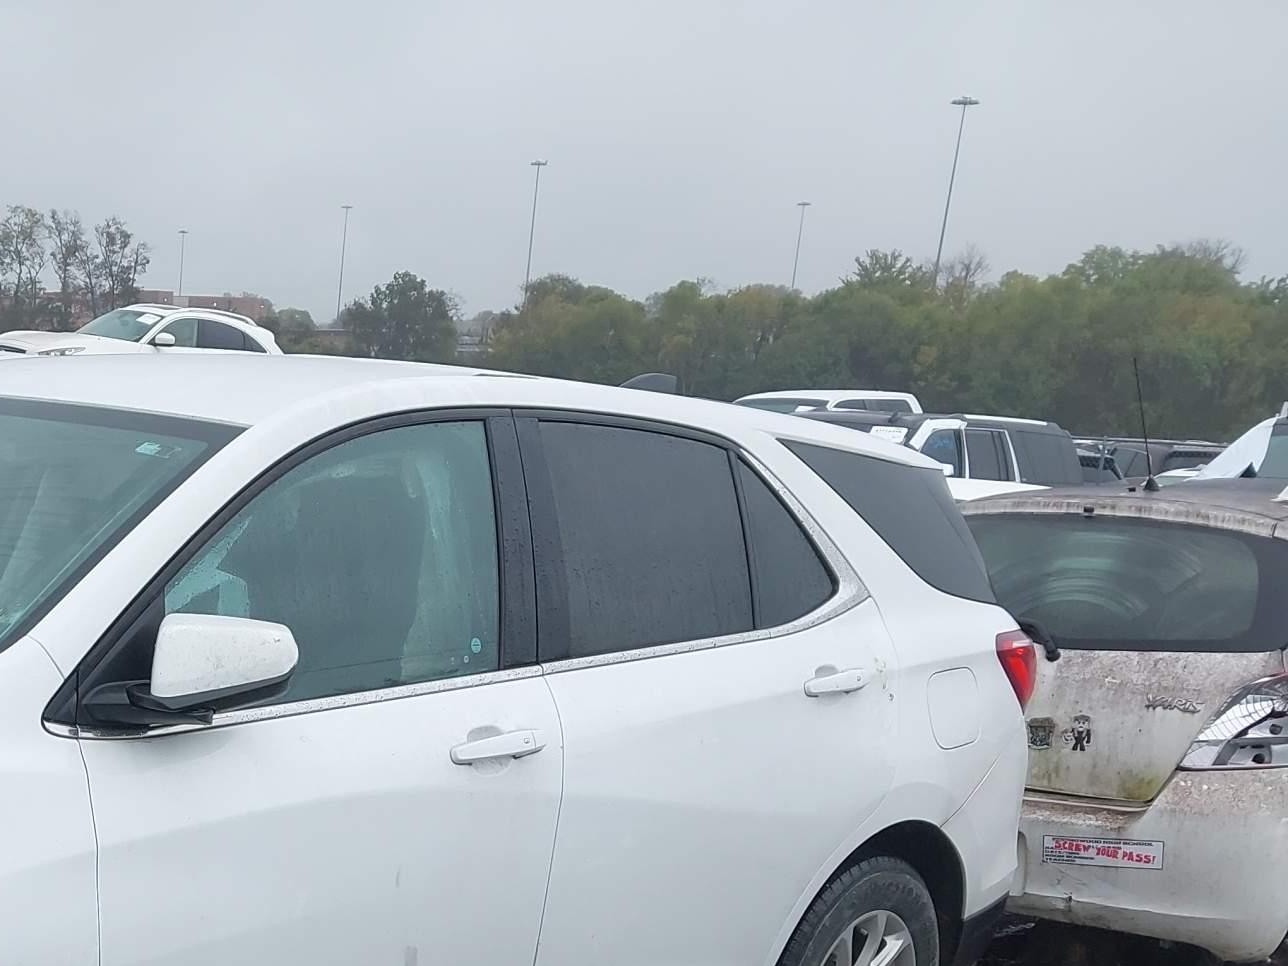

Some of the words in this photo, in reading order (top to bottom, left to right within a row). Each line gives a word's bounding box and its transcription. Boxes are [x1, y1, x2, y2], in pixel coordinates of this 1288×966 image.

[1145, 693, 1206, 714] YARIS
[1054, 840, 1091, 852] SCREW
[1095, 847, 1120, 859] YOUR
[1122, 850, 1157, 865] PASS!
